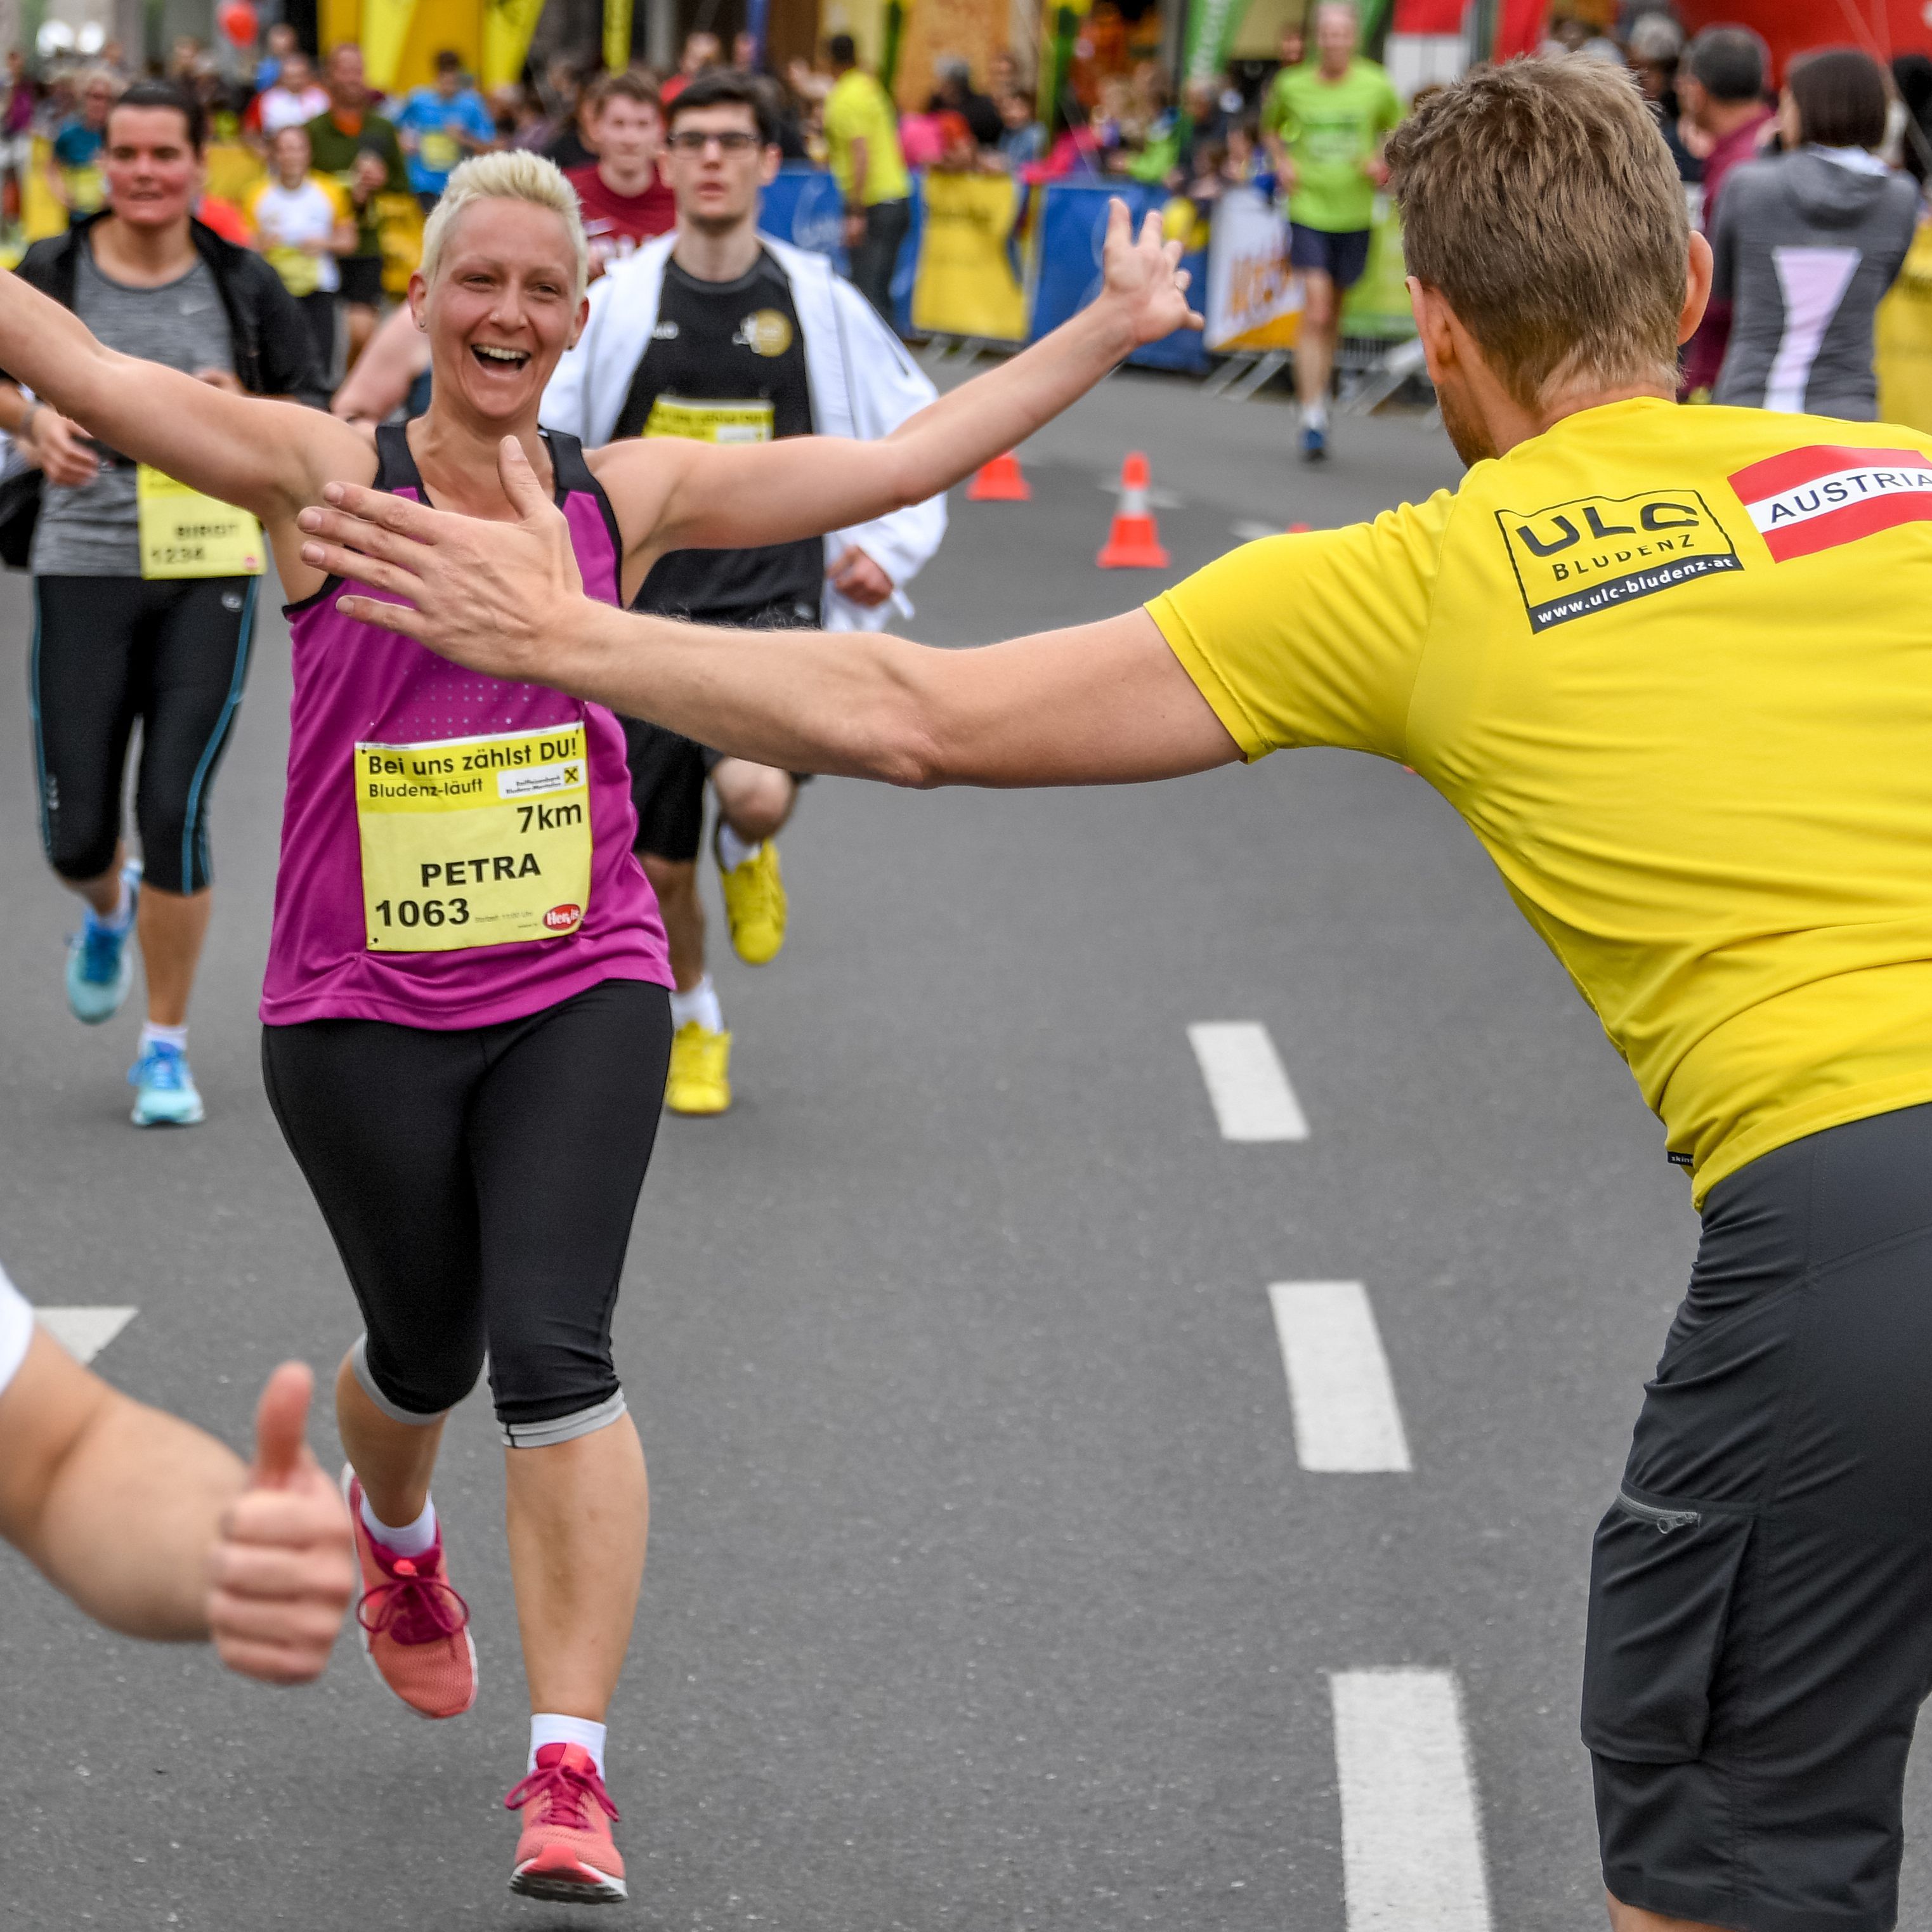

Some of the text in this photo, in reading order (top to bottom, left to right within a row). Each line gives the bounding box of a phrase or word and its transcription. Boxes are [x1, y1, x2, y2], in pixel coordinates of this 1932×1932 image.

[1771, 473, 1932, 523] AUSTRIA
[1515, 502, 1700, 558] ULC
[1552, 534, 1695, 582] BLUDENZ
[1537, 558, 1733, 623] www.ulc-bludenz.at
[369, 738, 576, 775] Bei uns zählst DU!
[369, 778, 483, 798] Bludenz-läuft
[421, 853, 542, 887] PETRA
[375, 898, 469, 927] 1063
